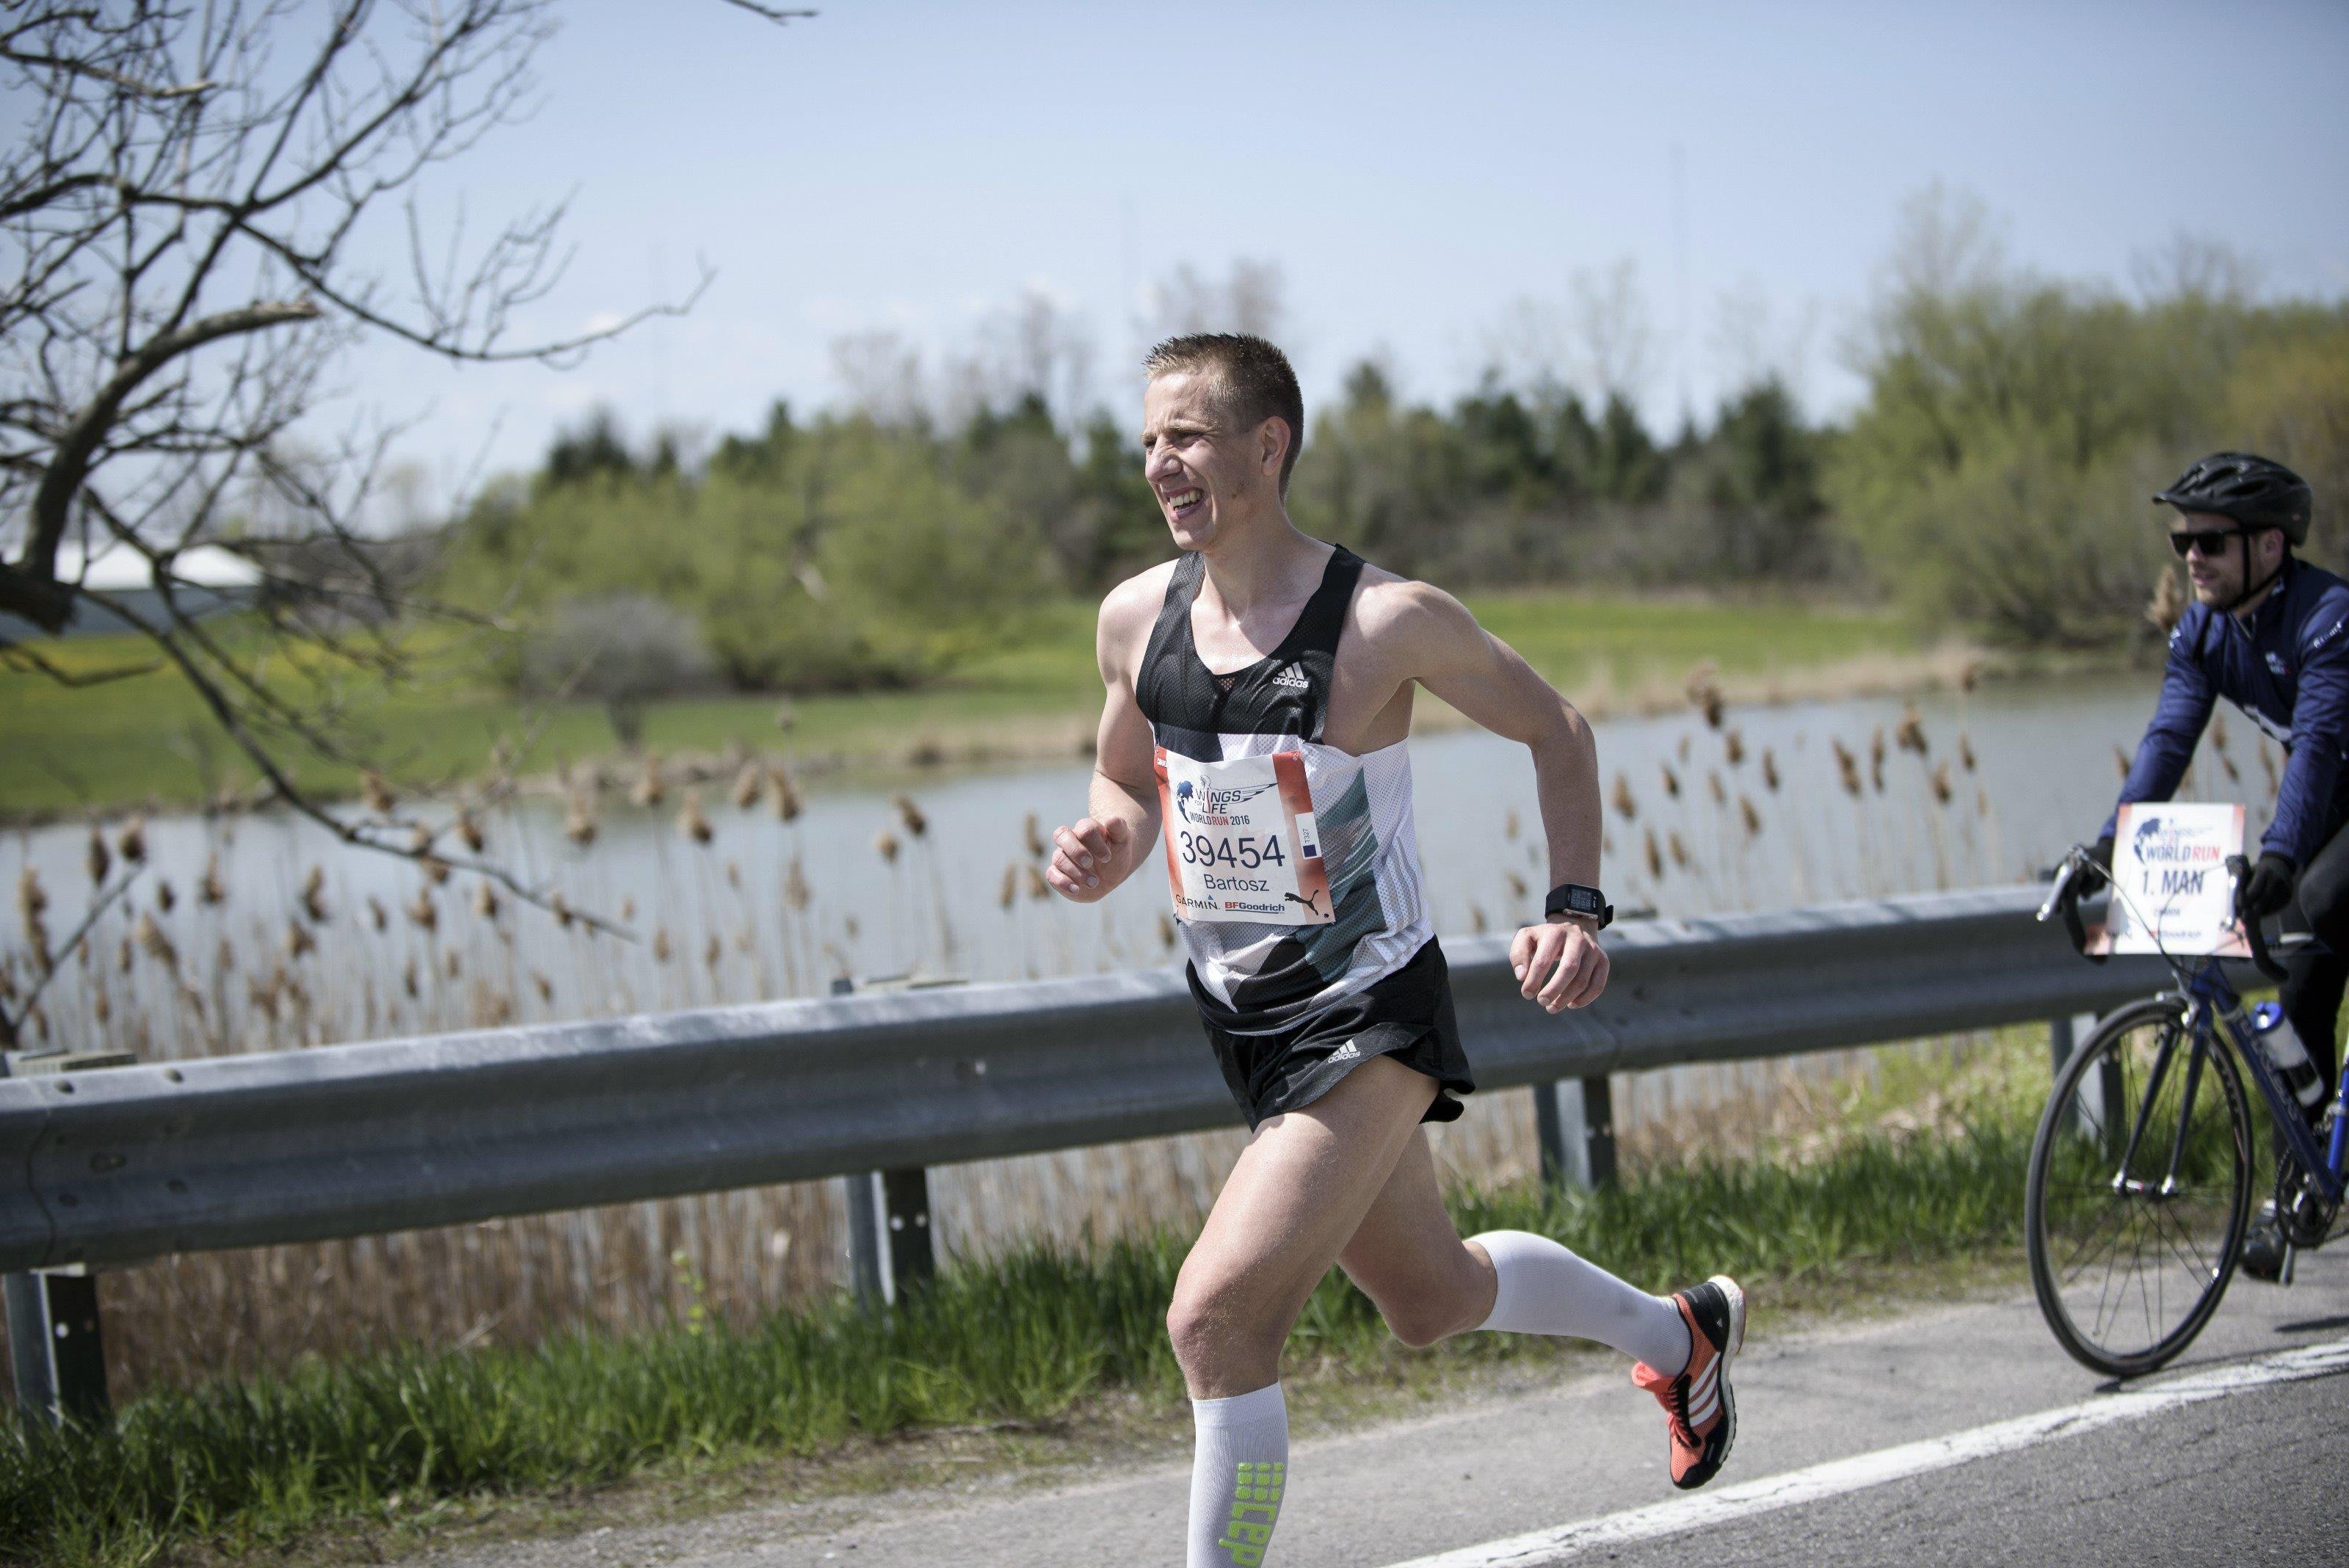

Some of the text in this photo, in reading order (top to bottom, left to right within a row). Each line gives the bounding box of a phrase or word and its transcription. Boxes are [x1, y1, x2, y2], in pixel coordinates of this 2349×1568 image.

[1272, 677, 1308, 688] adidas
[1230, 815, 1250, 825] 2016
[1302, 828, 1310, 843] T327
[1180, 830, 1285, 869] 39454
[1204, 874, 1270, 892] Bartosz
[2161, 868, 2205, 896] MAN
[1175, 894, 1219, 910] GARMIN
[1224, 901, 1285, 912] BFGoodrich
[1327, 1050, 1361, 1063] adidas
